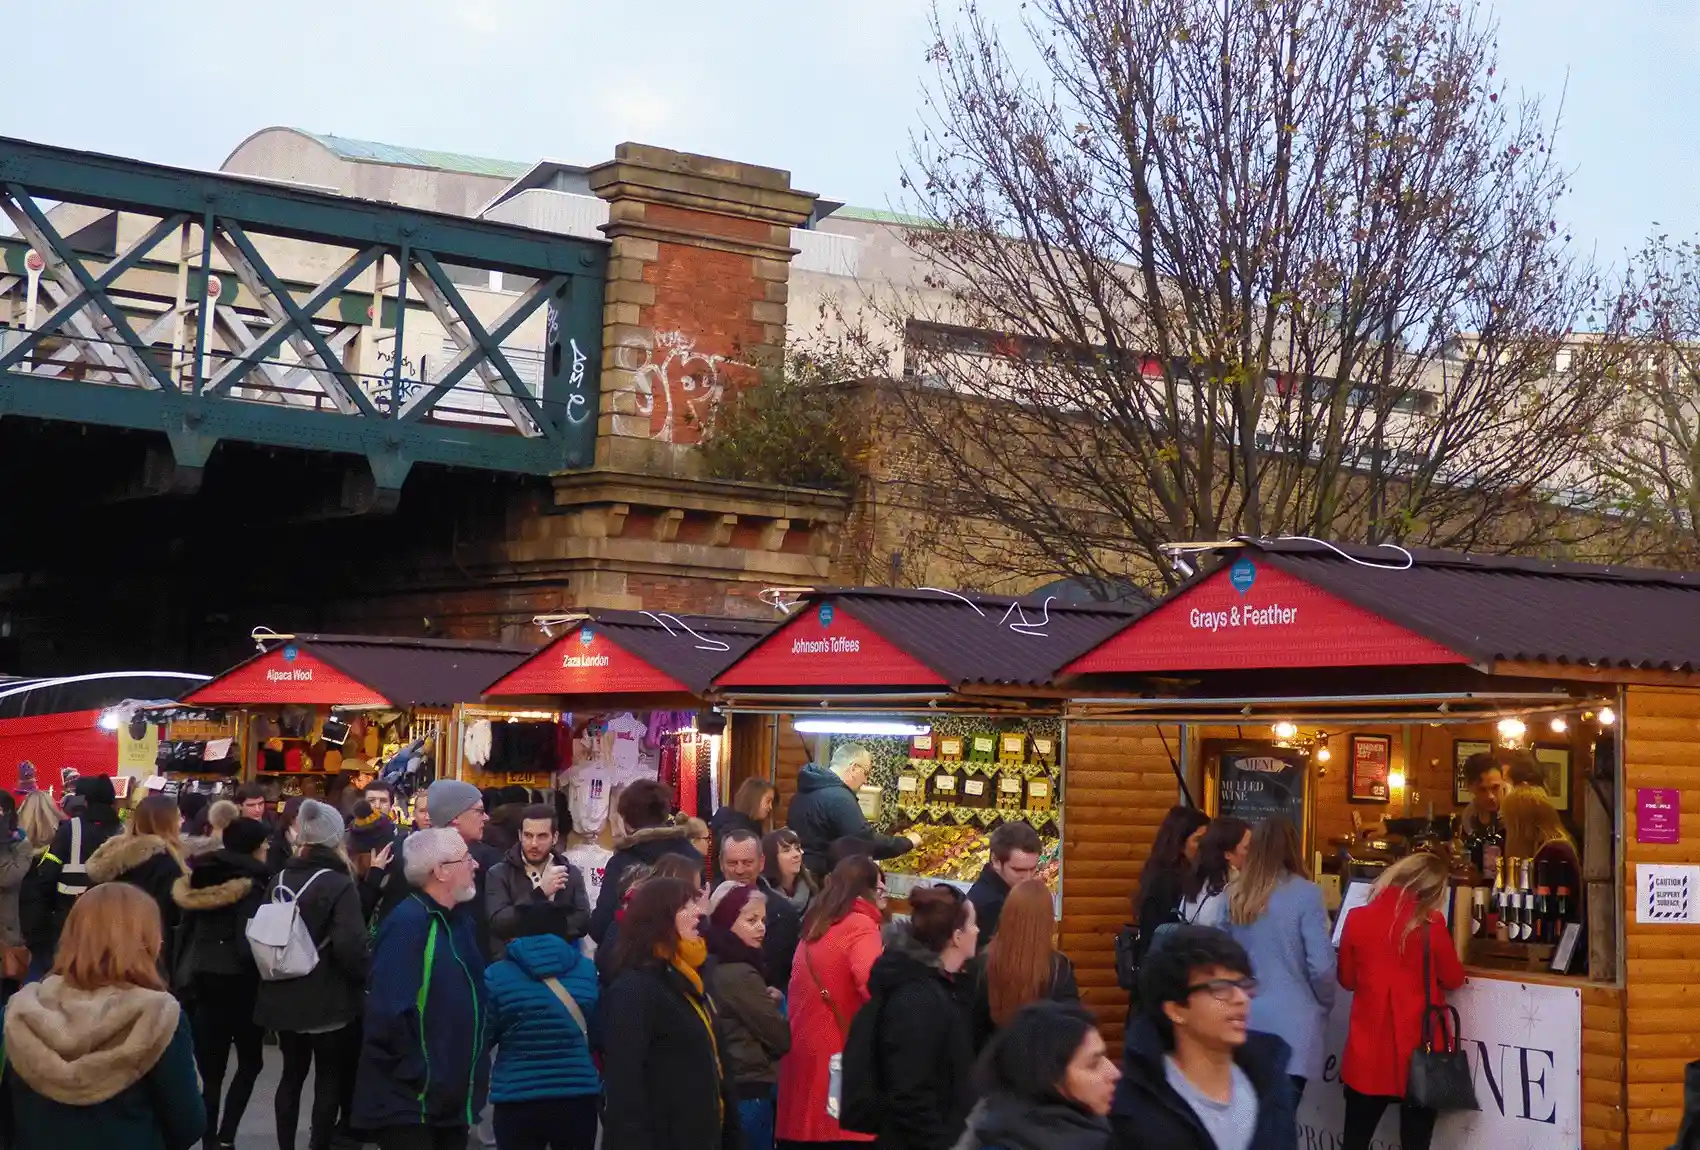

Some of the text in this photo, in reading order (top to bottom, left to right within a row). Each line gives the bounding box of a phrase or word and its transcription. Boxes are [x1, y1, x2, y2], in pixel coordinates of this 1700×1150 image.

[1190, 603, 1298, 632] Grays & Feather
[791, 636, 860, 653] Johnson's Toffees
[563, 653, 609, 667] Zaza London
[266, 668, 313, 683] Alpaca Wool
[1221, 780, 1264, 792] MULLED
[1372, 786, 1385, 796] 25
[1221, 790, 1248, 801] WINE
[1655, 878, 1681, 887] CAUTION
[1656, 891, 1681, 899] SLIPPERY
[1657, 899, 1680, 907] SURFACE
